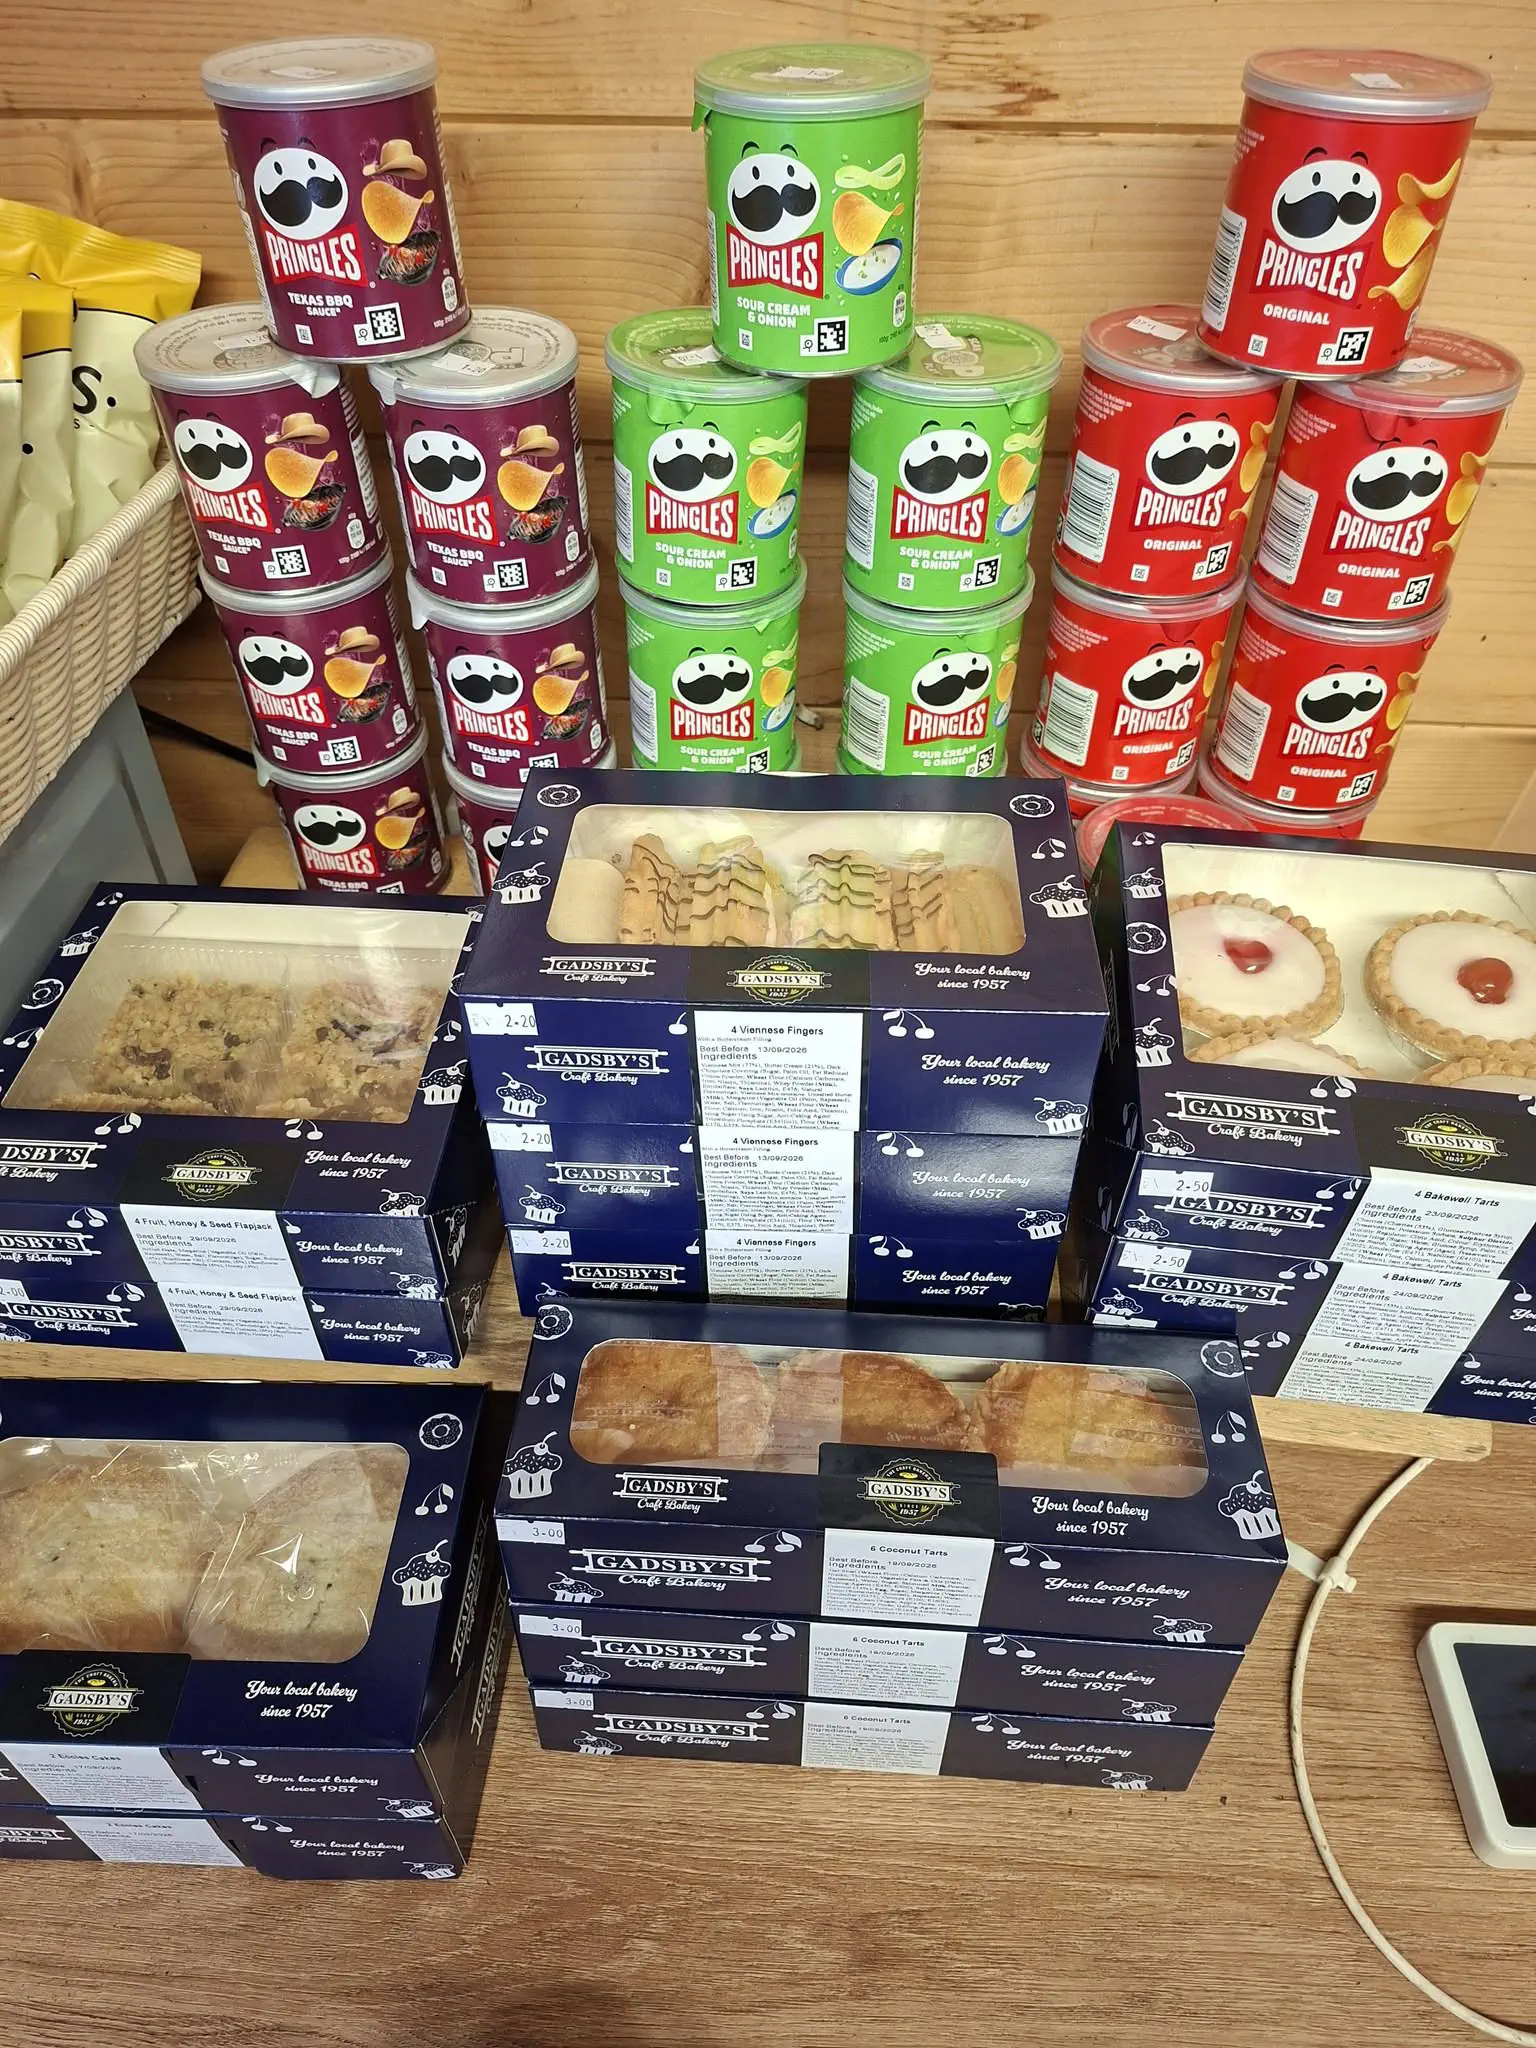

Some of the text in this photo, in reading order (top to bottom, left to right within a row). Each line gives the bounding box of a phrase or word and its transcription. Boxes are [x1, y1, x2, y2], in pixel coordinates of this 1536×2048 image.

[265, 231, 361, 281] PRINGLES
[730, 232, 818, 291] PRINGLES
[1256, 239, 1364, 301] PRINGLES
[288, 292, 353, 308] TEXAS BBQ
[736, 296, 811, 316] SOUR CREAM
[747, 312, 796, 328] & ONION
[1263, 303, 1330, 325] ORIGINAL
[187, 479, 267, 528] PRINGLES
[1134, 487, 1227, 527] PRINGLES
[411, 489, 493, 541] PRINGLES
[649, 489, 734, 538] PRINGLES
[894, 494, 984, 538] PRINGLES
[207, 530, 262, 549] TEXAS BBQ
[1329, 510, 1432, 557] PRINGLES
[426, 541, 484, 561] TEXAS BBQ
[655, 541, 727, 559] SOUR CREAM
[900, 546, 973, 560] SOUR CREAM
[1143, 539, 1203, 551] ORIGINAL
[676, 556, 713, 569] ONION
[921, 560, 960, 570] ONION
[1337, 563, 1400, 579] ORIGINAL
[248, 682, 325, 724] PRINGLES
[452, 700, 529, 742] PRINGLES
[673, 704, 751, 738] PRINGLES
[908, 702, 987, 742] PRINGLES
[1113, 697, 1194, 736] PRINGLES
[265, 724, 295, 738] TEXAS
[466, 741, 497, 755] TEXAS
[1123, 741, 1173, 754] ORIGINAL
[1283, 722, 1373, 760] PRINGLES
[680, 745, 744, 757] SOUR CREAM
[912, 745, 977, 759] SOUR CREAM
[700, 756, 734, 765] ONION
[933, 756, 966, 766] ONION
[1290, 765, 1347, 778] ORIGINAL
[302, 843, 375, 875] PRINGLES
[556, 960, 641, 973] GADSBY'S
[914, 963, 1031, 980] Your local bakery
[564, 973, 628, 984] Craft Bakery
[741, 975, 818, 984] GADSBY'S
[937, 979, 1009, 990] since 1957
[740, 1026, 784, 1035] Viennese
[787, 1026, 824, 1036] Fingers
[545, 1052, 650, 1068] GADSBY'S
[700, 1053, 757, 1061] Ingredients
[922, 1054, 1051, 1072] Your local bakery
[560, 1070, 638, 1086] Craft Bakery
[943, 1074, 1023, 1087] since 1957
[1188, 1099, 1317, 1128] GADSBY'S
[741, 1138, 782, 1146] Viennese
[784, 1138, 819, 1147] Fingers
[1207, 1123, 1303, 1147] Craft Bakery
[1411, 1133, 1492, 1151] GADSBY'S
[305, 1150, 412, 1168] Your local bakery
[704, 1160, 757, 1168] Ingredients
[176, 1168, 249, 1180] GADSBY'S
[319, 1168, 388, 1179] since 1957
[564, 1168, 662, 1182] GADSBY'S
[579, 1183, 651, 1197] Craft Bakery
[1424, 1191, 1472, 1204] Bakewell
[1474, 1197, 1501, 1207] Tarts
[1179, 1196, 1308, 1221] GADSBY'S
[1360, 1209, 1422, 1222] Ingredients
[143, 1218, 167, 1227] Fruit,
[169, 1219, 198, 1229] Honey
[209, 1220, 232, 1229] Seed
[235, 1221, 273, 1231] Flapjack
[1189, 1214, 1283, 1236] Craft Bakery
[578, 1266, 670, 1280] GADSBY'S
[1391, 1273, 1436, 1285] Bakewell
[1438, 1279, 1462, 1288] Tarts
[1151, 1275, 1271, 1299] GADSBY'S
[13, 1304, 117, 1321] GADSBY'S
[34, 1320, 111, 1335] Craft Bakery
[628, 1479, 713, 1496] GADSBY'S
[871, 1483, 947, 1498] GADSBY'S
[637, 1498, 700, 1513] Craft Bakery
[1032, 1496, 1149, 1521] Your local bakery
[532, 1527, 563, 1538] 3-00
[1056, 1520, 1129, 1536] since 1957
[879, 1546, 920, 1555] Coconut
[924, 1549, 948, 1557] Tarts
[597, 1556, 744, 1575] GADSBY'S
[829, 1562, 886, 1570] Ingredients
[618, 1574, 726, 1591] Craft Bakery
[552, 1623, 581, 1634] 3-00
[605, 1642, 743, 1660] GADSBY'S
[245, 1680, 358, 1702] Your local bakery
[54, 1693, 129, 1706] GADSBY'S
[260, 1703, 333, 1719] since 1957
